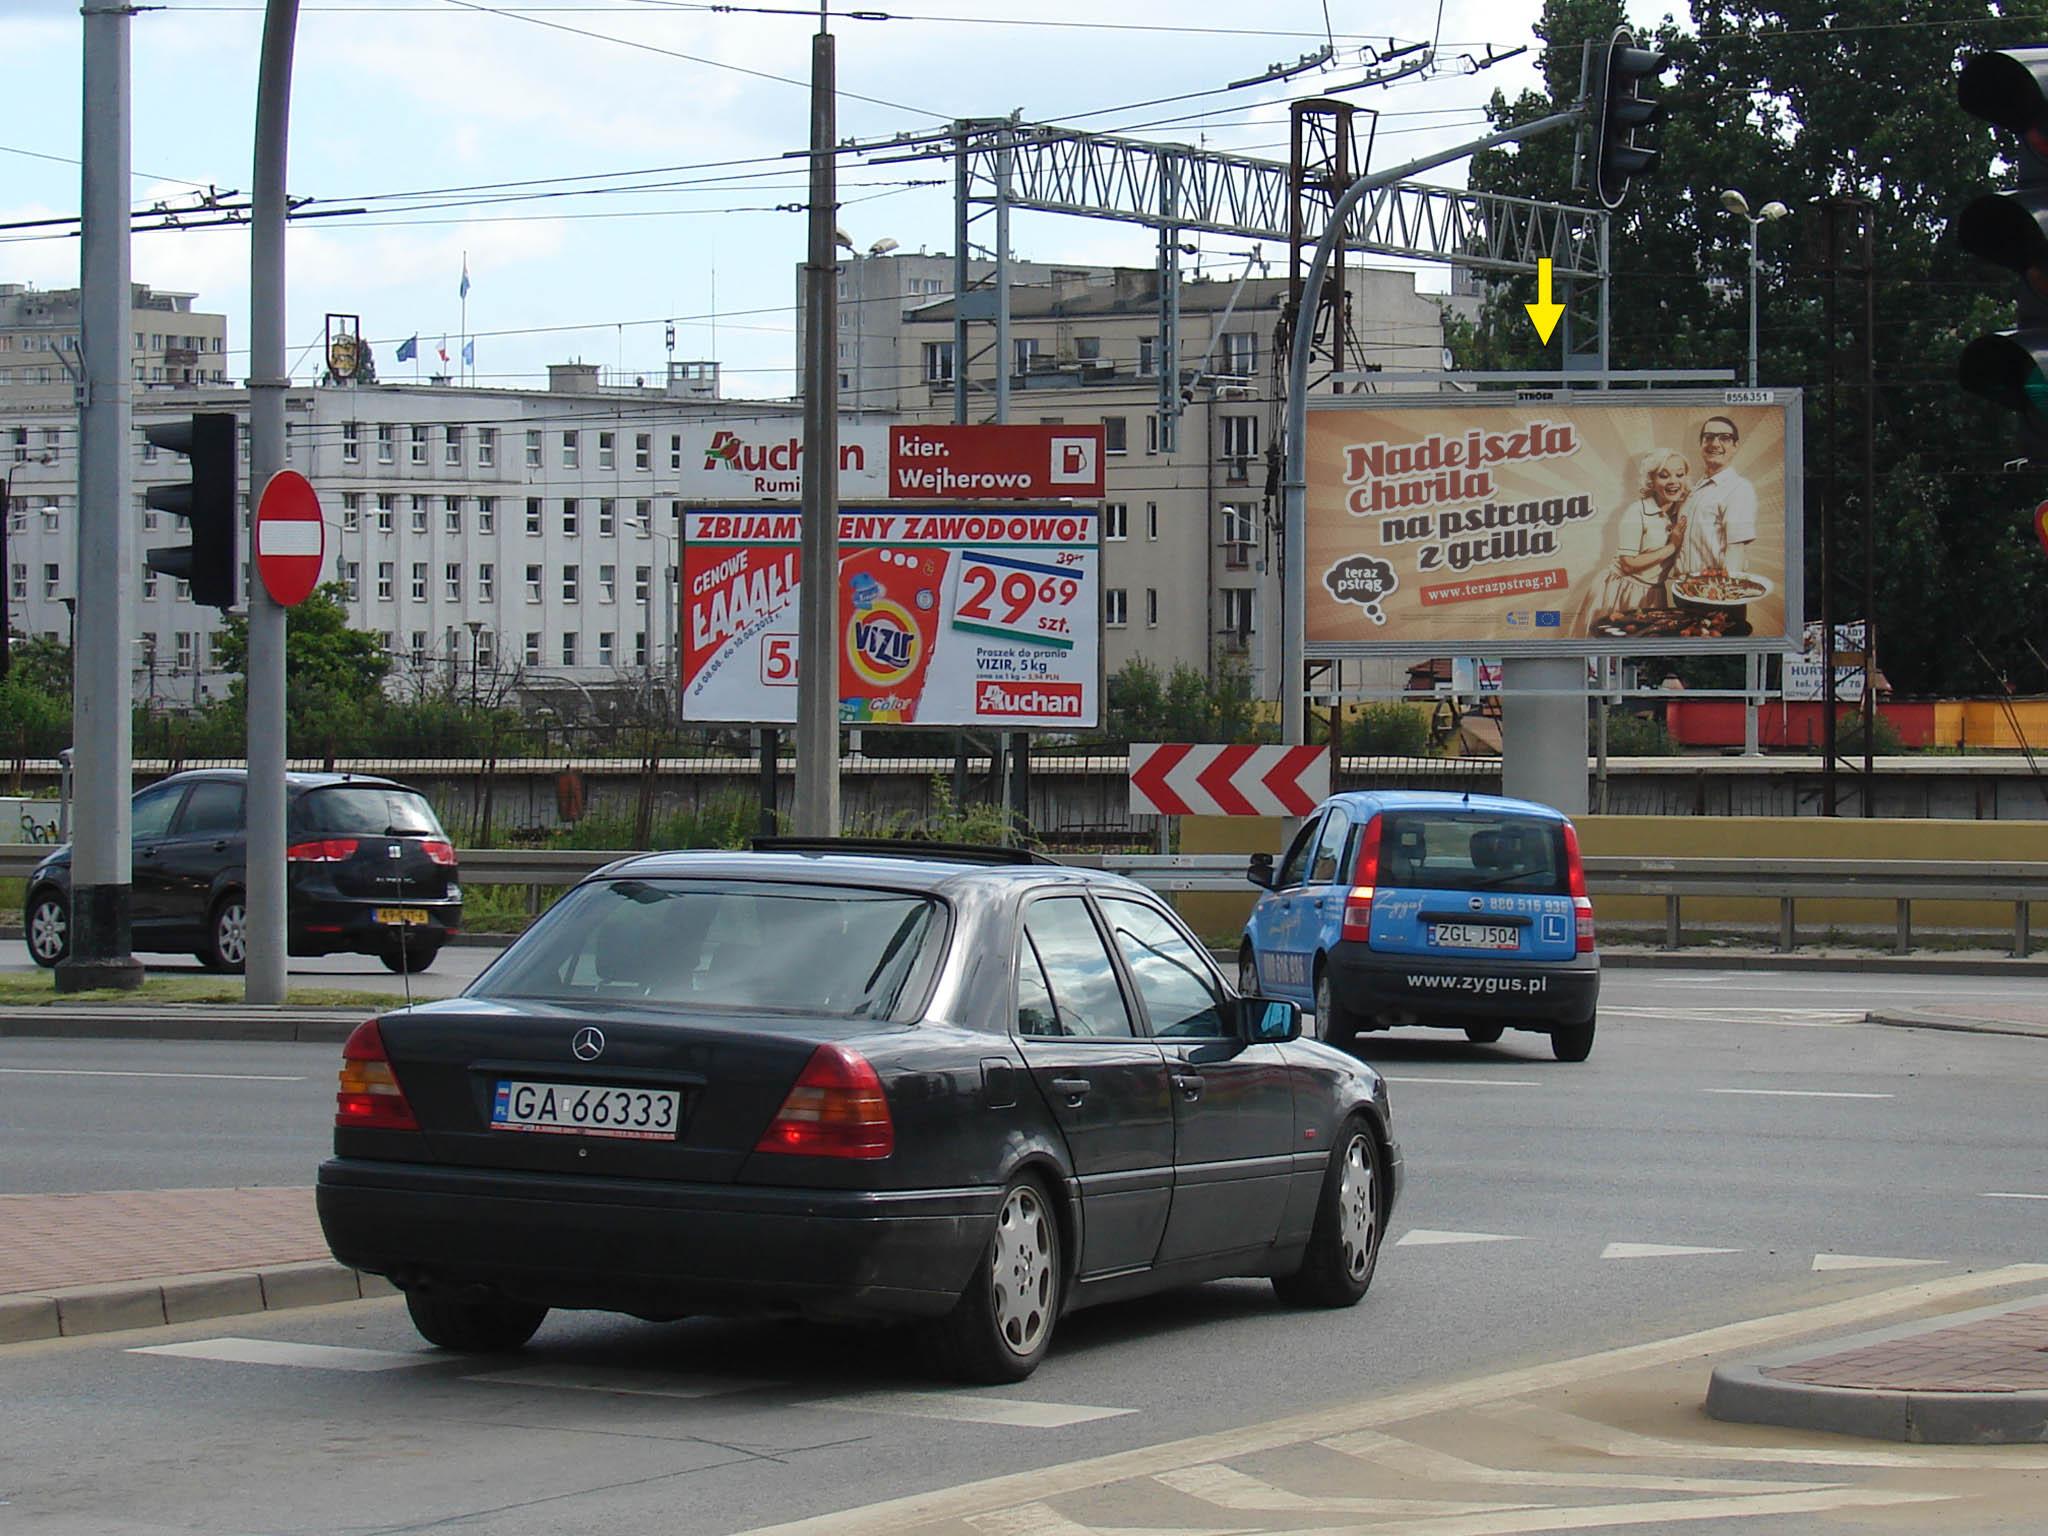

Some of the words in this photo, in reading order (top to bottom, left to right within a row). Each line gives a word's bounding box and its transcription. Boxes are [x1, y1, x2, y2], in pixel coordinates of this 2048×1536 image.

[704, 431, 864, 471] Auchn
[898, 435, 950, 457] kier.
[1347, 423, 1577, 480] Nadejszła
[755, 476, 801, 493] Rumi
[898, 467, 1032, 494] Wejherowo
[1350, 470, 1495, 513] chwila
[697, 516, 803, 539] ZBIJAM
[838, 517, 896, 539] ENY
[902, 517, 1089, 541] ZAWODOWO!
[1382, 514, 1434, 543] na
[1419, 546, 1442, 569] z
[693, 549, 749, 596] CENOWE
[1344, 566, 1378, 578] teraz
[1337, 577, 1383, 592] pstrąg
[1427, 571, 1558, 601] www.terazpstrag.pl
[1037, 616, 1071, 634] szt.
[976, 647, 1015, 657] Proszek
[1018, 648, 1031, 658] do
[1033, 649, 1068, 660] prania
[976, 658, 1017, 673] VIZIR,
[1020, 659, 1028, 671] 5
[1031, 660, 1047, 674] kg
[868, 694, 912, 712] Color
[979, 684, 1079, 713] Auchan
[1438, 924, 1472, 943] ZGL
[1480, 926, 1517, 944] J504
[1549, 916, 1560, 937] L
[1407, 974, 1547, 994] www.zygus.pl
[514, 1085, 558, 1121] GA
[571, 1089, 673, 1128] 66333
